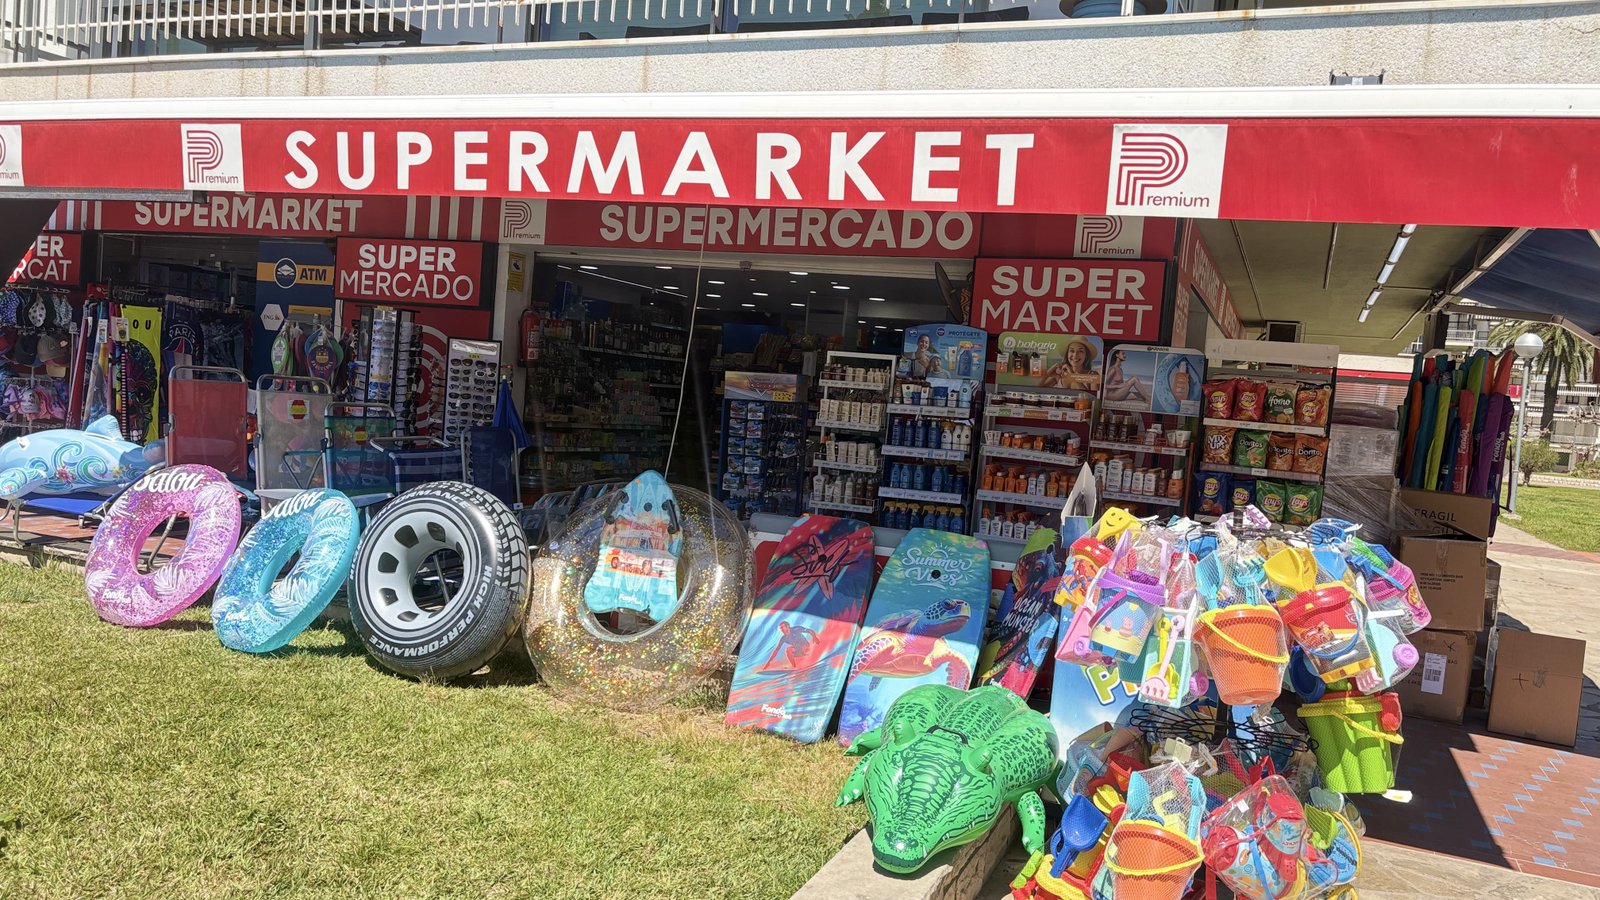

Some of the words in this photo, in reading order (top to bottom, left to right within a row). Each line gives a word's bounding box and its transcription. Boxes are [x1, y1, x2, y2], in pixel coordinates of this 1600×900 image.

[284, 130, 1035, 206] SUPERMARKET
[135, 196, 363, 232] SUPERMARKET
[599, 204, 974, 251] SUPERMERCADO
[358, 243, 457, 273] SUPER
[300, 268, 327, 281] ATM
[340, 270, 474, 301] MERCADO
[990, 265, 1146, 300] SUPER
[979, 300, 1154, 336] MARKET
[168, 327, 196, 344] PARIS
[1016, 339, 1057, 350] babaria
[1414, 508, 1457, 522] FRAGIL
[902, 547, 973, 573] Summer
[474, 564, 493, 611] HIGH
[905, 567, 963, 586] Vies
[1013, 597, 1043, 616] OCEAN
[369, 612, 475, 657] PERFORMANCE
[1002, 611, 1040, 635] MONSTER
[761, 703, 786, 715] Fonda
